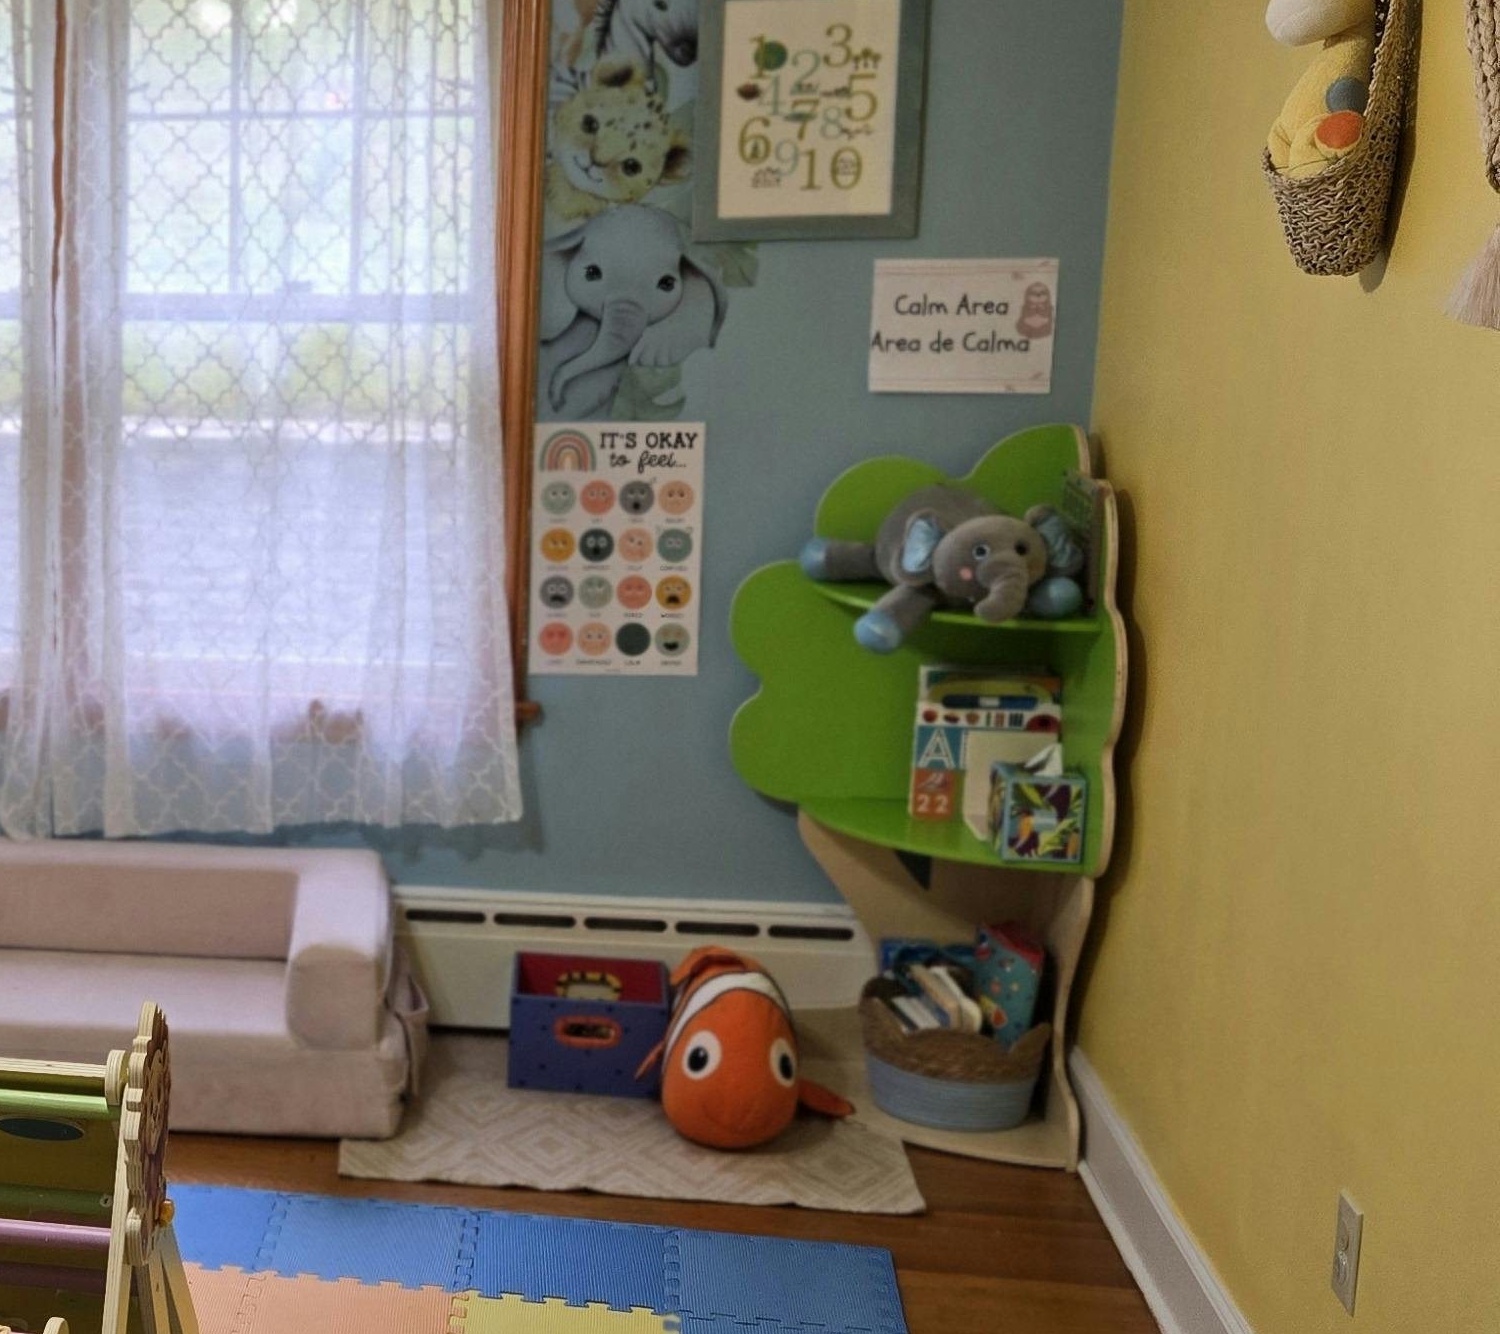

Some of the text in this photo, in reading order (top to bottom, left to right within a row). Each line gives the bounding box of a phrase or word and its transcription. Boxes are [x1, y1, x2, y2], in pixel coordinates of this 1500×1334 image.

[790, 49, 821, 96] 2
[823, 23, 853, 67] 3
[757, 73, 878, 122] 4 5
[738, 98, 843, 165] 6 7 8
[775, 139, 863, 191] 9 10
[894, 293, 1009, 317] Calm Area
[871, 329, 1030, 354] Area de Calma
[600, 431, 698, 450] IT'S OKAY
[610, 452, 631, 468] to
